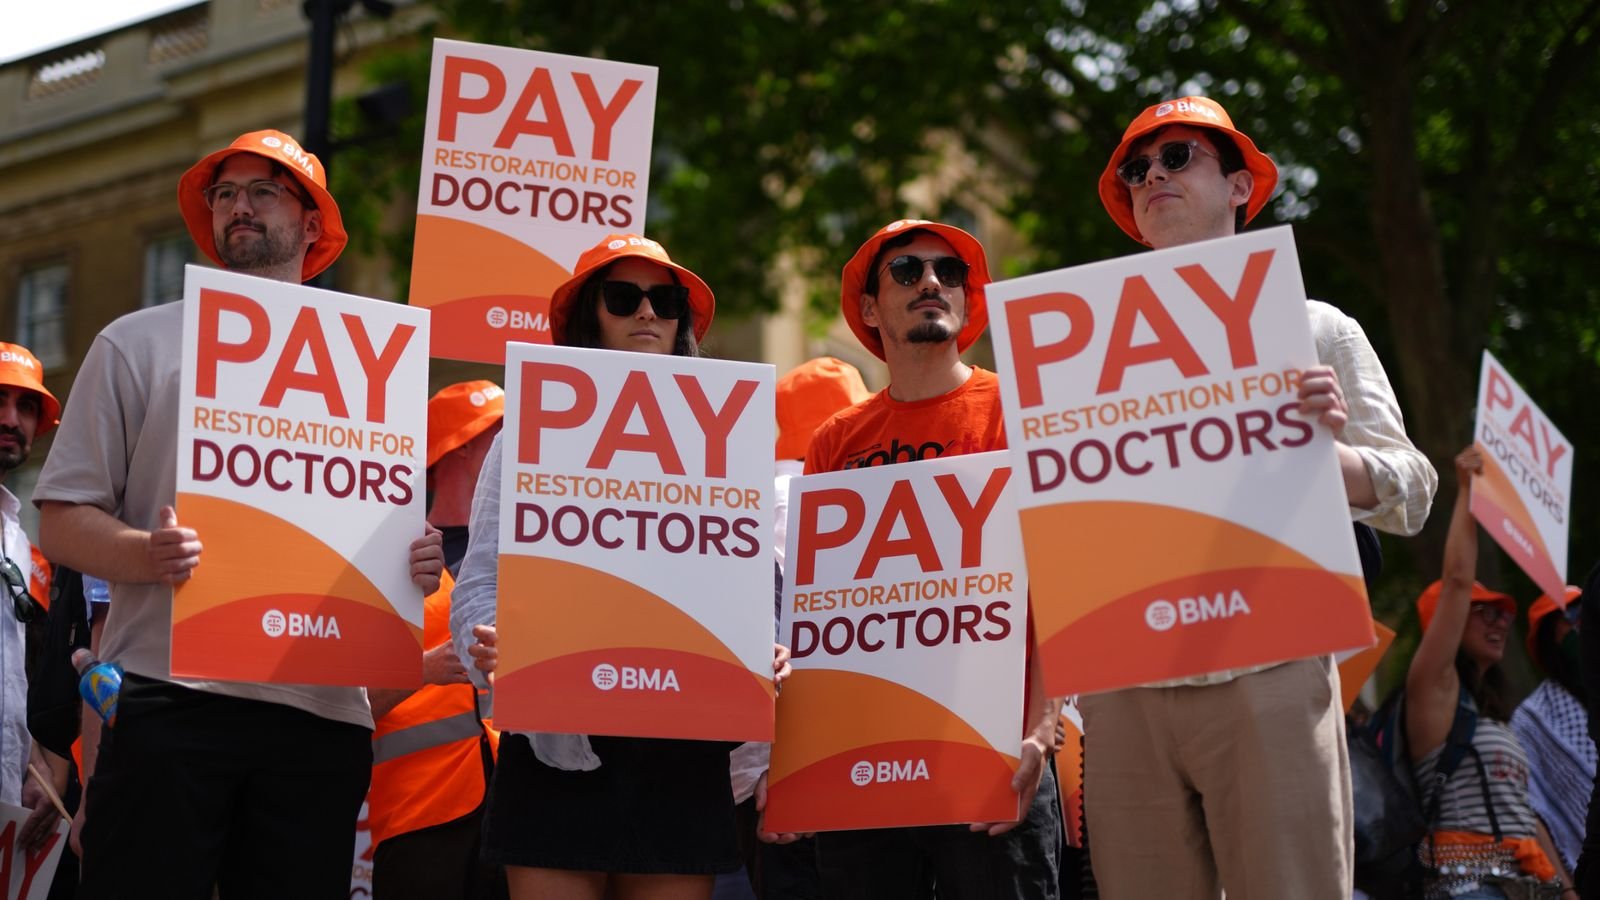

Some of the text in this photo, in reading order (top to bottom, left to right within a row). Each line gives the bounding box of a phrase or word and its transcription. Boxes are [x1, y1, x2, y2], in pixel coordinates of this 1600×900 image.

[437, 55, 644, 161] PAY
[1177, 101, 1220, 121] BMA
[283, 143, 314, 179] BMA
[434, 148, 637, 189] RESTORATION FOR
[431, 173, 633, 228] DOCTORS
[195, 287, 416, 424] PAY
[1004, 248, 1276, 410] PAY
[1, 351, 35, 370] BMA
[193, 406, 415, 458] RESTORATION FOR
[517, 361, 760, 479] PAY
[1022, 368, 1303, 441] RESTORATION FOR
[1486, 365, 1566, 480] PAY
[192, 438, 413, 505] DOCTORS
[1027, 402, 1314, 493] DOCTORS
[1482, 423, 1563, 524] DOCTORS
[516, 472, 761, 510] RESTORATION FOR
[514, 502, 760, 558] DOCTORS
[795, 467, 1012, 586] PAY
[793, 572, 1013, 613] RESTORATION FOR
[1178, 590, 1251, 625] BMA
[288, 612, 341, 640] BMA
[790, 601, 1012, 659] DOCTORS
[621, 667, 680, 692] BMA
[876, 758, 930, 783] BMA
